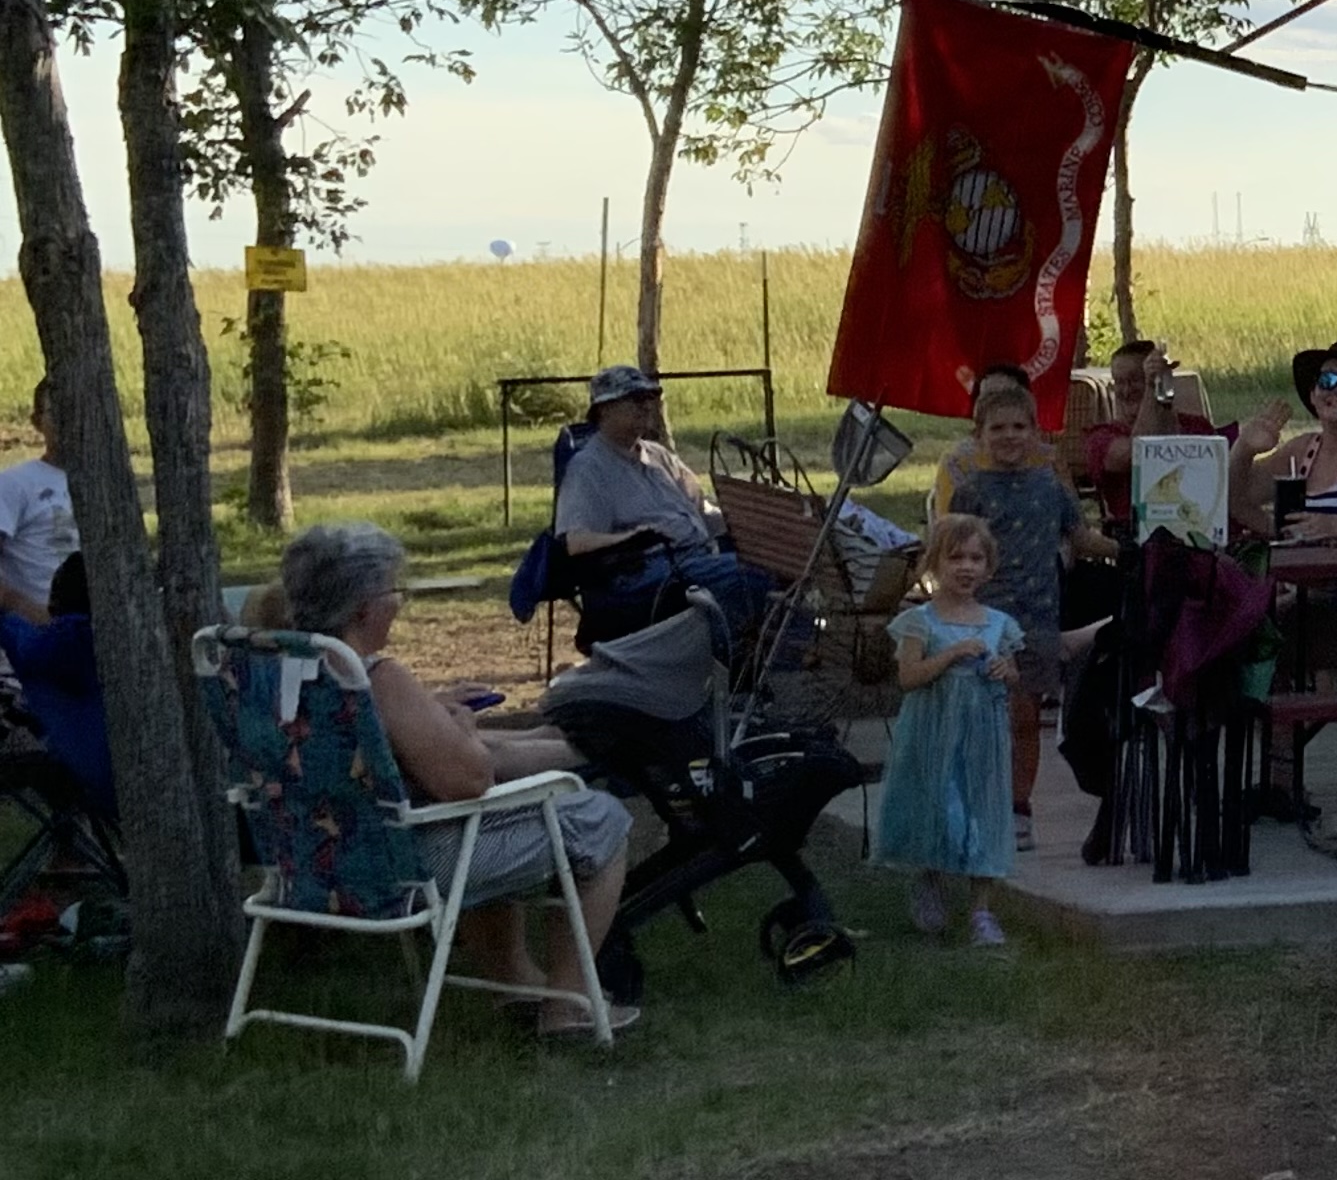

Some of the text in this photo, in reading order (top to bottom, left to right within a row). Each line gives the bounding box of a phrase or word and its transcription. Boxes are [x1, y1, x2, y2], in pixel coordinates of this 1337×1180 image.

[1037, 246, 1070, 317] STATES
[1060, 146, 1086, 221] MARINE
[1144, 444, 1214, 462] FRANZIA
